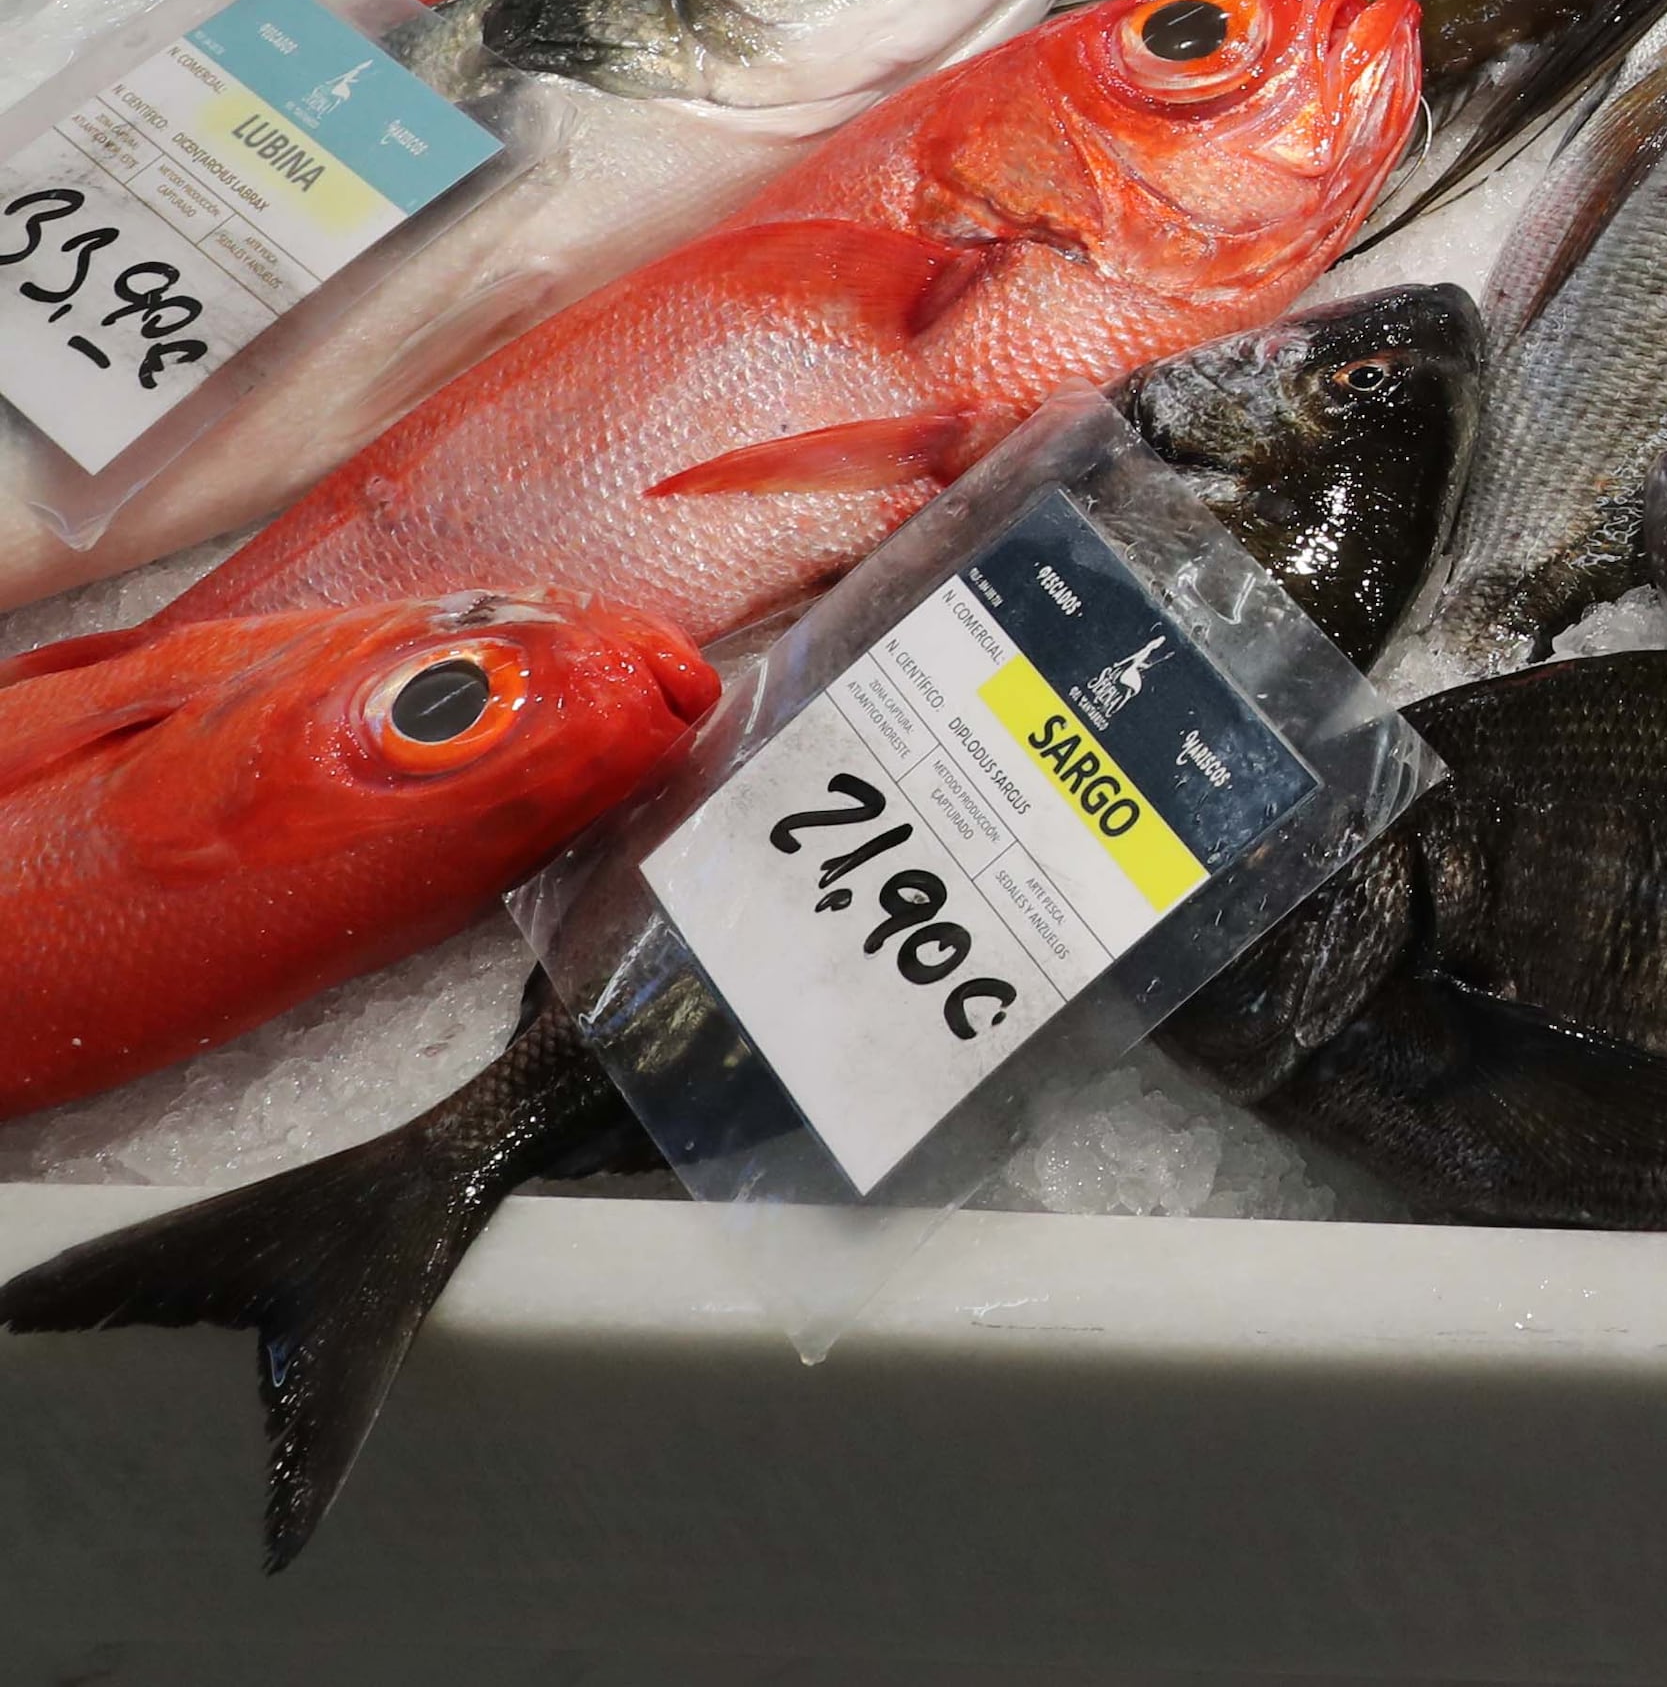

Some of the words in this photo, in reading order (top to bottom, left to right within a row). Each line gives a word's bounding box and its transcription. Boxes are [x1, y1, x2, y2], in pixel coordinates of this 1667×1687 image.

[176, 53, 228, 95] COMERCIAL:
[231, 113, 326, 193] LUBINA
[171, 131, 238, 185] DICENTARCHUS
[229, 179, 270, 213] LABRAX
[868, 679, 888, 702] ZONA
[884, 697, 914, 735] CAPTURA:
[942, 589, 956, 606] N.
[952, 601, 1004, 663] COMERCIAL:
[1027, 714, 1140, 837] SARGO
[1036, 565, 1082, 615] PESCADOS
[1175, 729, 1231, 787] MARISCOS
[846, 680, 884, 725] ATLANTICO
[878, 720, 911, 759] NORESTE
[885, 638, 900, 656] N.
[895, 651, 944, 709] CIENTÍFICO:
[948, 716, 998, 773] DIPLODUS
[990, 769, 1031, 815] SARGUS
[930, 787, 974, 840] CAPTURADO
[932, 759, 963, 795] METODO
[956, 791, 1000, 843] PRODUCCIÓN:
[994, 869, 1029, 909] SEDALES
[1023, 903, 1034, 915] Y
[1025, 877, 1046, 900] ARTE
[1040, 895, 1065, 926] PESCA:
[1028, 912, 1070, 960] ANZUELOS
